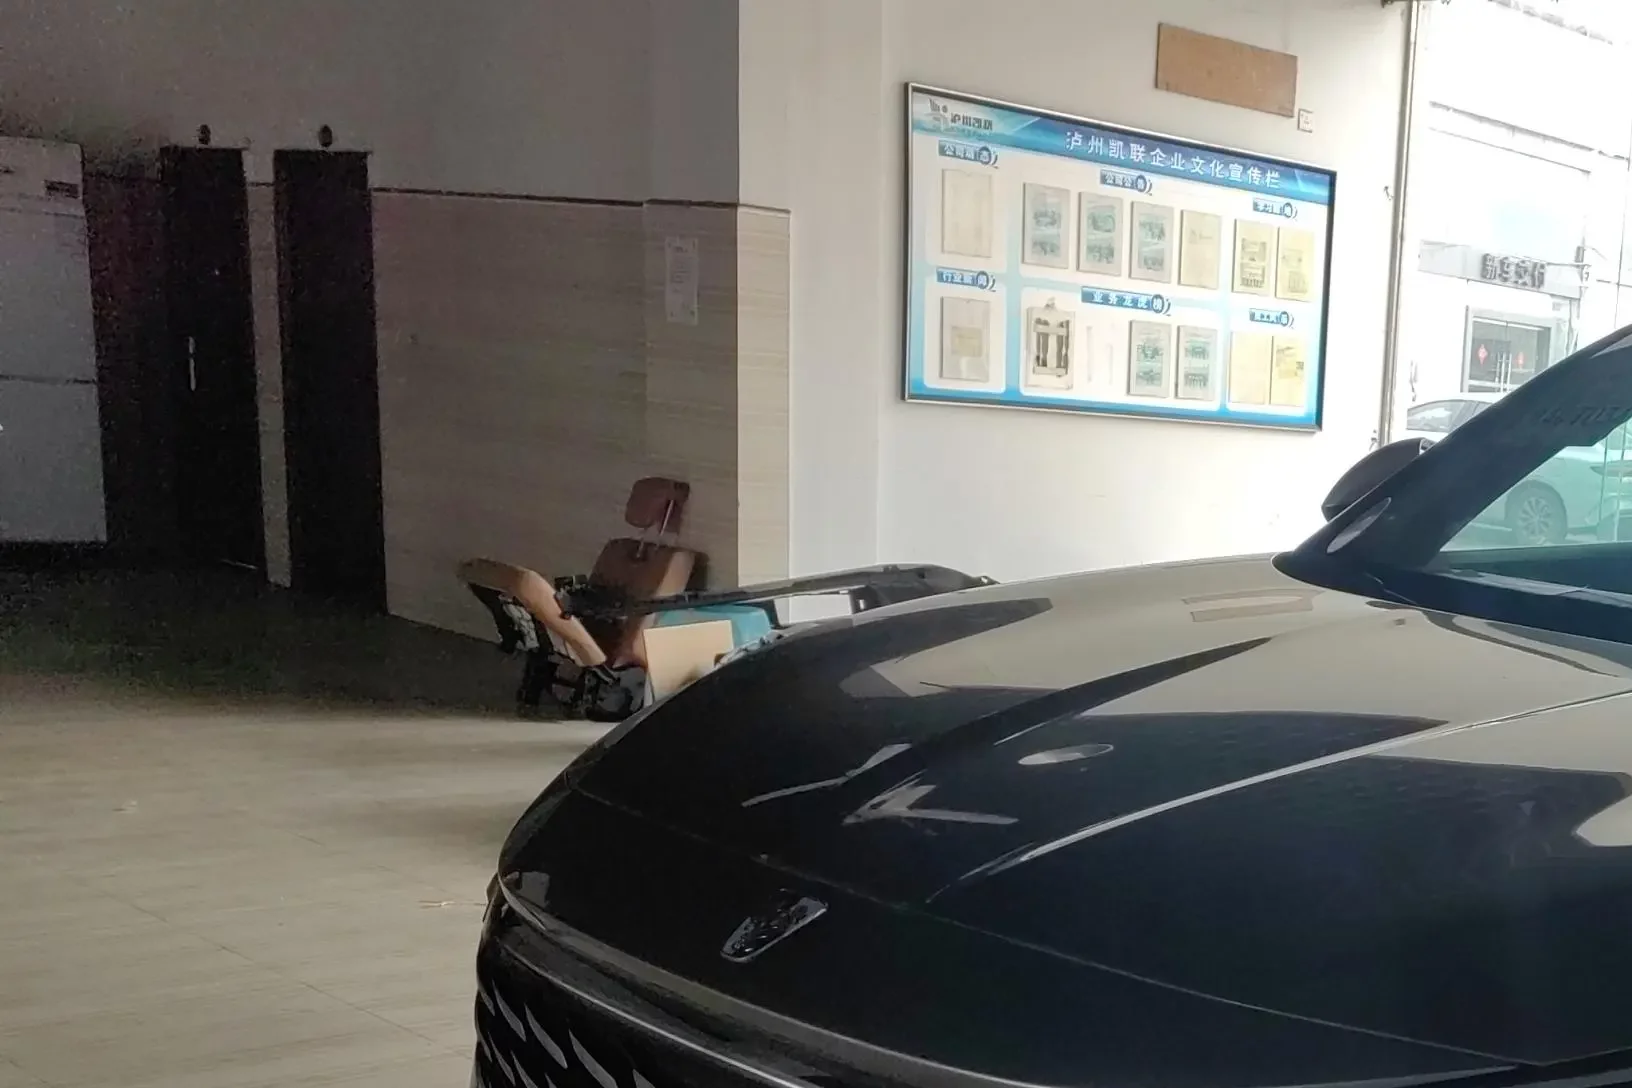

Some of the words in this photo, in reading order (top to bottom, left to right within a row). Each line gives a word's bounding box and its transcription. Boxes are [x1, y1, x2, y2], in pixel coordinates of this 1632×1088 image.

[1065, 130, 1282, 189] 泸州凯联企业文化宣传栏
